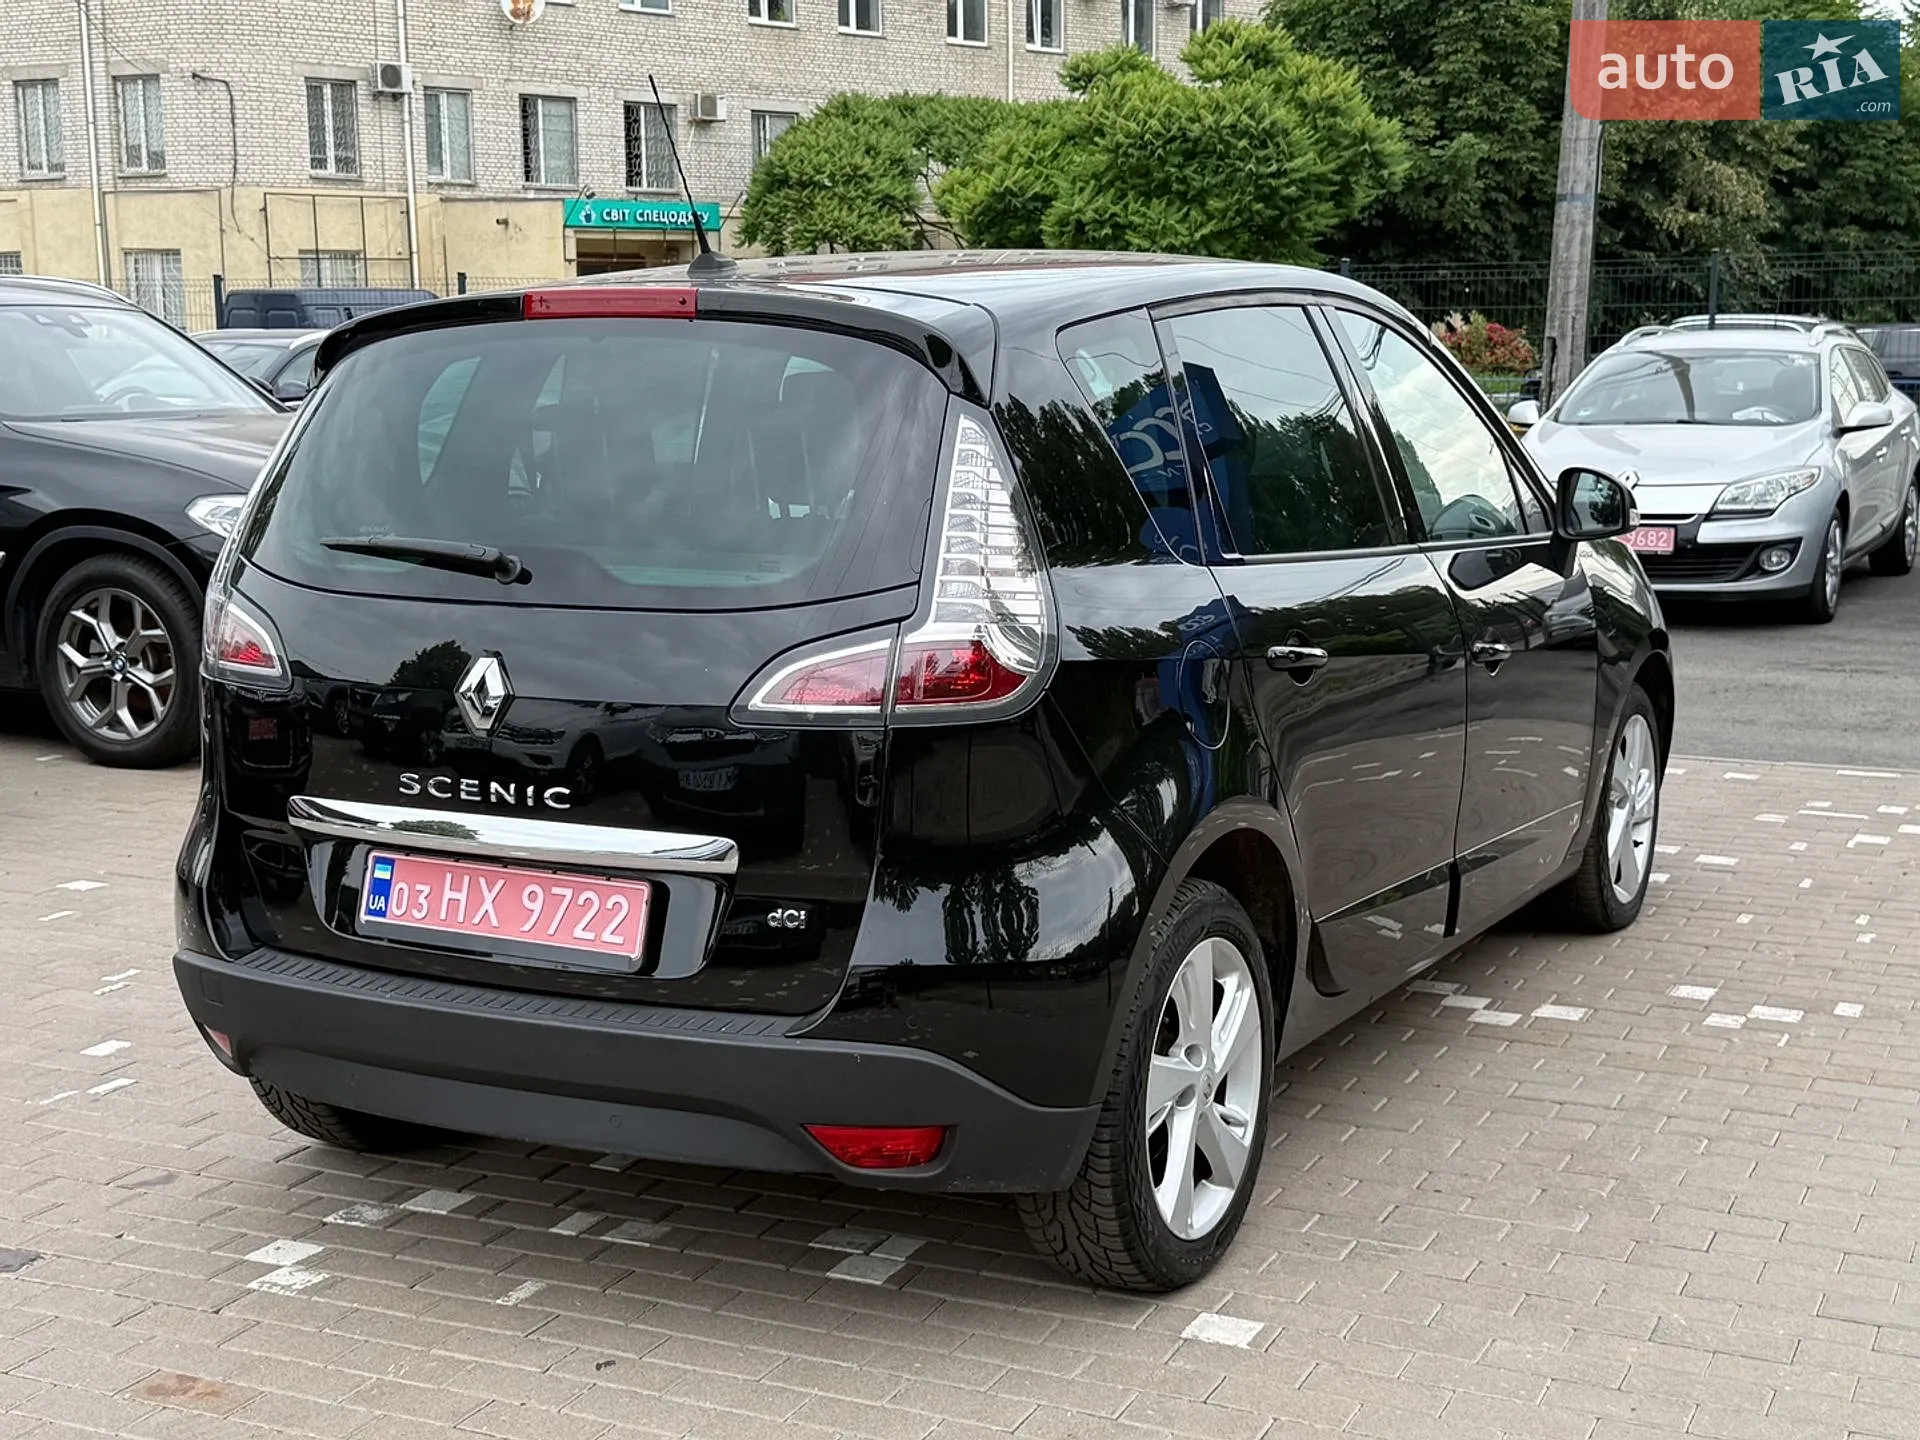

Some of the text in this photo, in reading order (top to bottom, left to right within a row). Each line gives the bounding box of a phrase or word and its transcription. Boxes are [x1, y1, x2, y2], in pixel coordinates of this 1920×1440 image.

[602, 208, 710, 225] СВІТ СПЕЦОДЯУ
[399, 772, 571, 809] SCENIC
[368, 894, 386, 912] UA
[391, 871, 630, 945] 03 HX 9722
[766, 908, 806, 929] dCi
